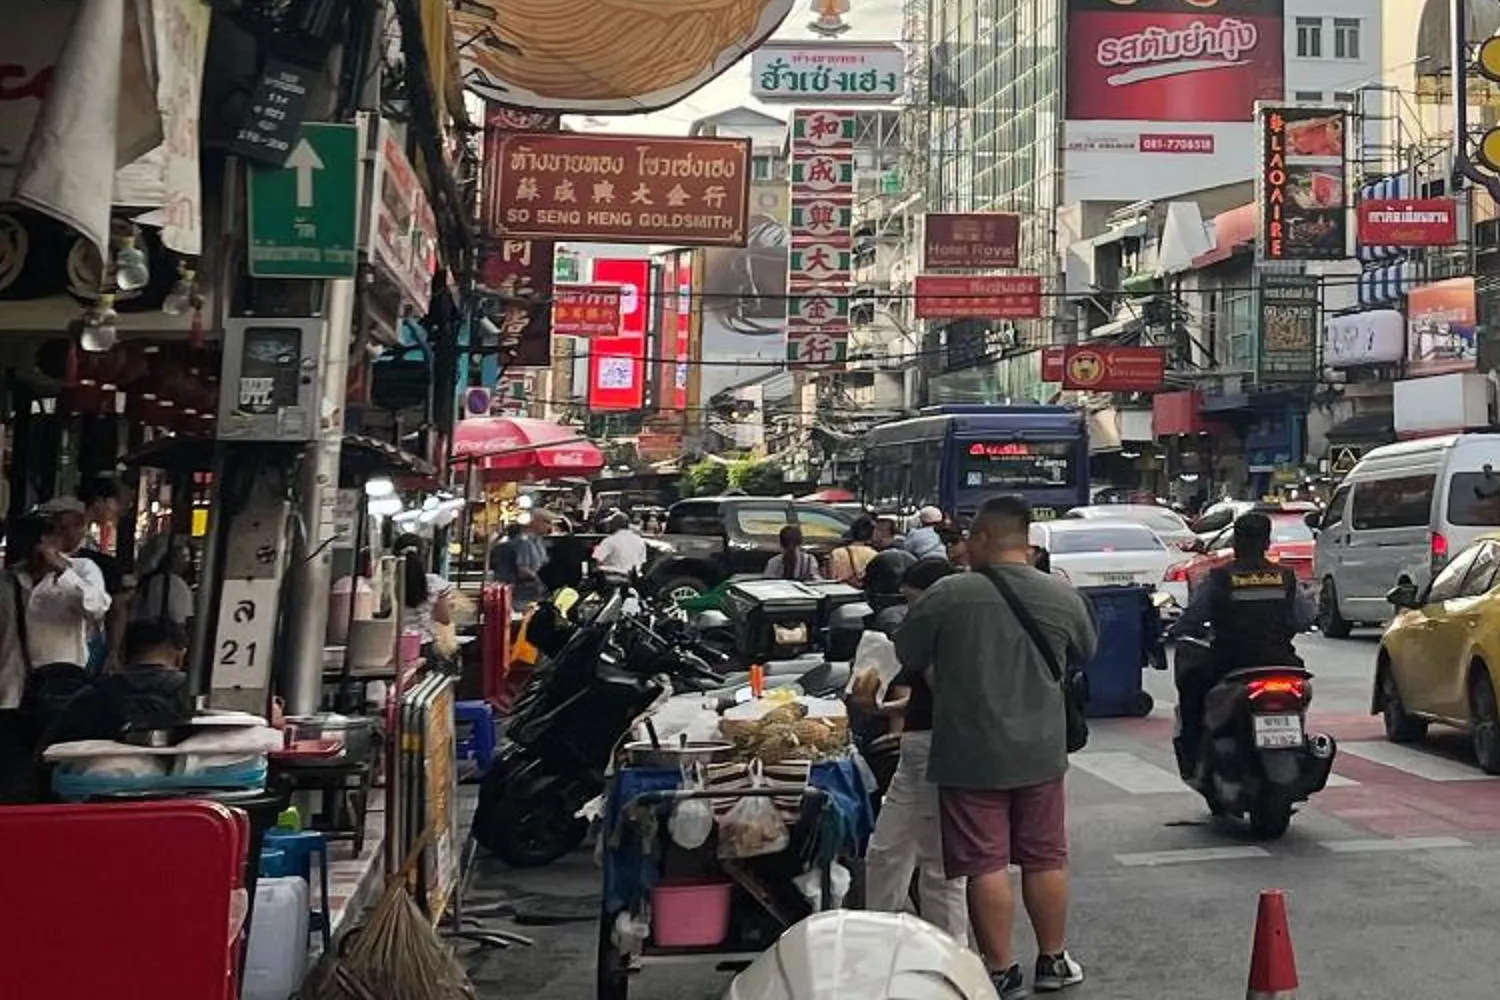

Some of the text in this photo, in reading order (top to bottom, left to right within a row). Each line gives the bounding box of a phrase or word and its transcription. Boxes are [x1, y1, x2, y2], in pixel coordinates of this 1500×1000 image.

[1098, 18, 1257, 66] รสต้มยำกุ้ง
[510, 145, 625, 174] ห้างขายทอง
[507, 209, 733, 229] SO SENG HENG GOLDSMITH
[799, 110, 842, 363] 和成興大金行
[220, 640, 258, 667] 21
